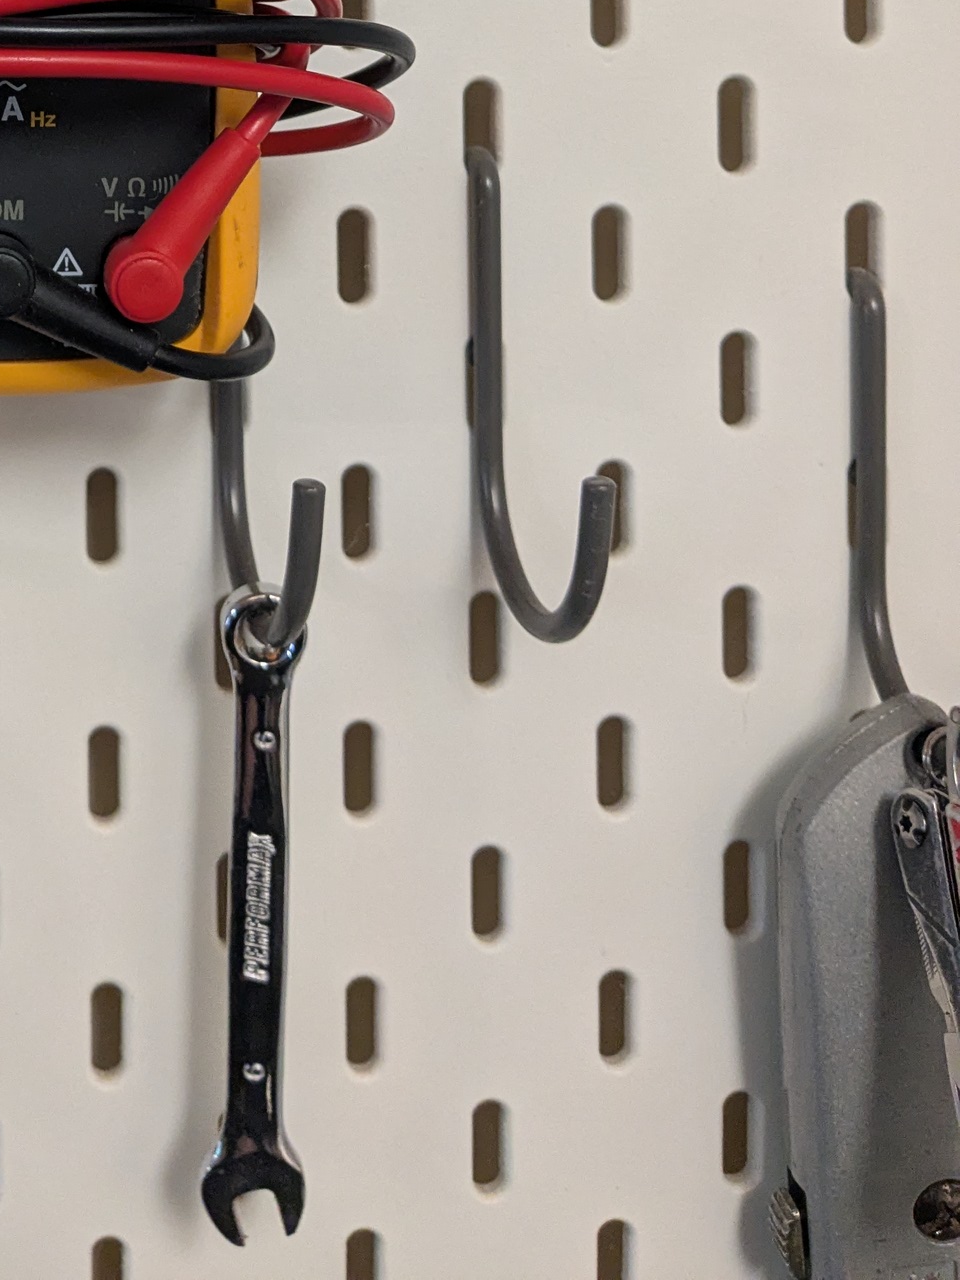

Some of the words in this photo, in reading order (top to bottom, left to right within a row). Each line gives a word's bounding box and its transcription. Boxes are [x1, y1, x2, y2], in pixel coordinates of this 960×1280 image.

[0, 95, 25, 122] A
[30, 110, 57, 128] Hz
[100, 177, 119, 198] V
[242, 831, 277, 984] PERFORMAX
